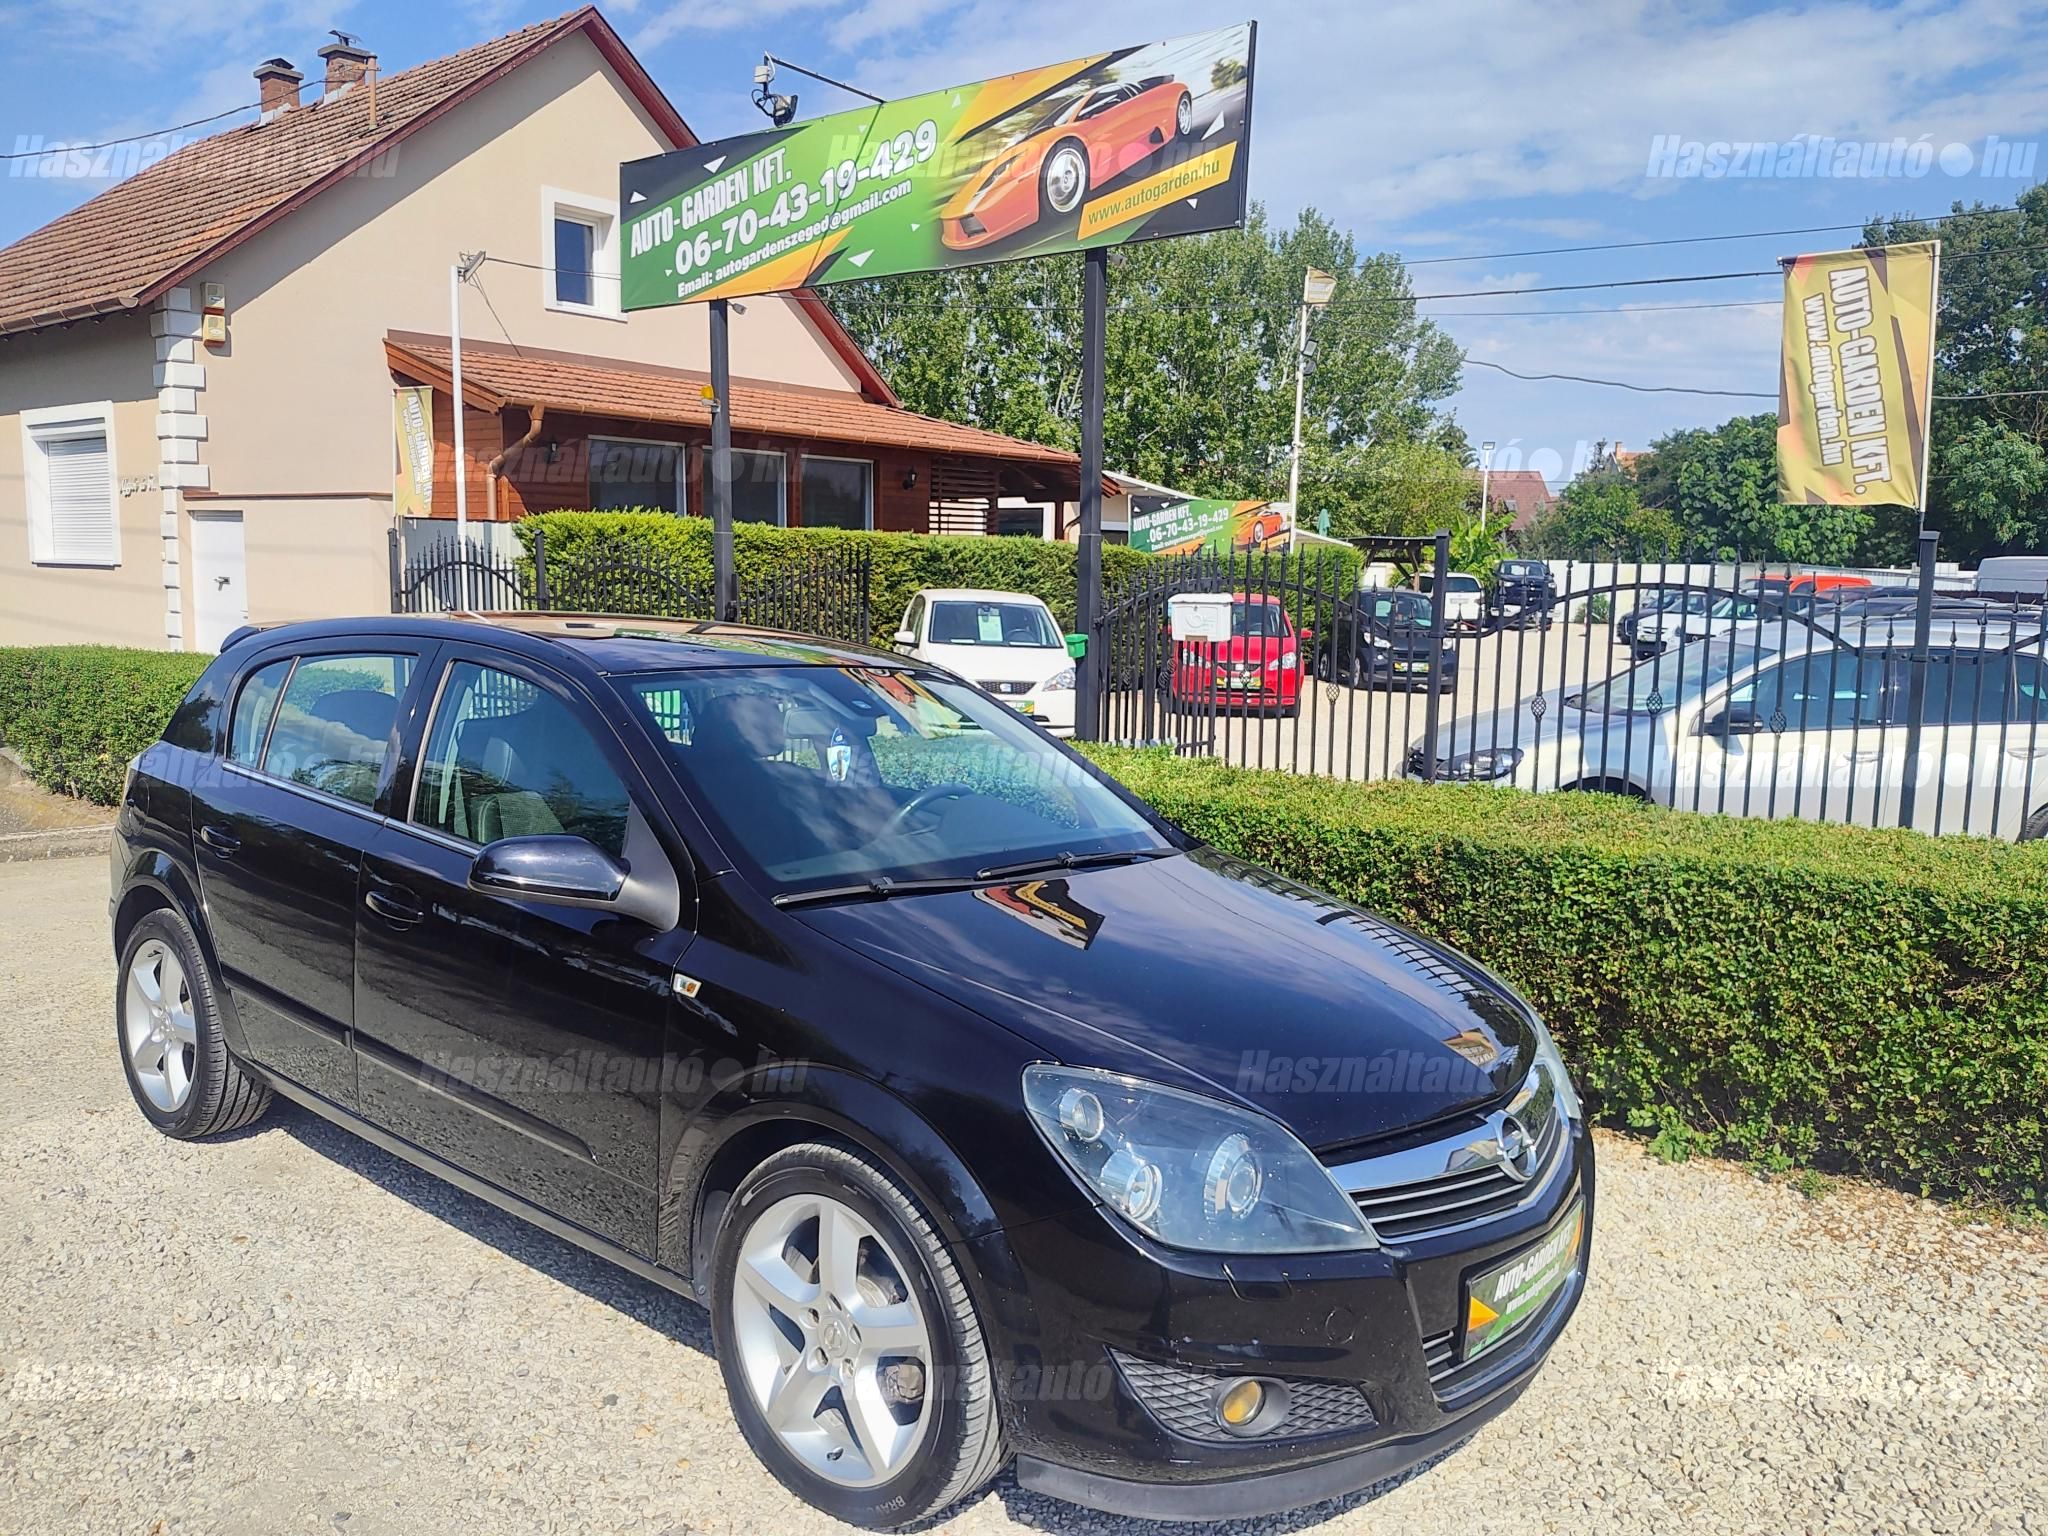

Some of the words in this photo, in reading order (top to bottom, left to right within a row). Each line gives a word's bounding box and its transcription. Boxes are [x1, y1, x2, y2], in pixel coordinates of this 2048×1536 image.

[630, 167, 749, 259] AUTO-GARDEN
[753, 147, 792, 196] KFT.
[675, 119, 938, 276] 06-70-43-19-429
[678, 273, 713, 298] Email:
[715, 178, 912, 281] autogardenszeged@gmail.com
[1088, 159, 1220, 225] www.autogarden.hu
[1803, 292, 1847, 467] www.autogarden.hu
[1828, 265, 1887, 437] AUTO-GARDEN
[1850, 436, 1892, 495] KFT.
[1133, 511, 1177, 533] AUTO-GARDEN
[1149, 507, 1229, 543] 06-70-43-19-429
